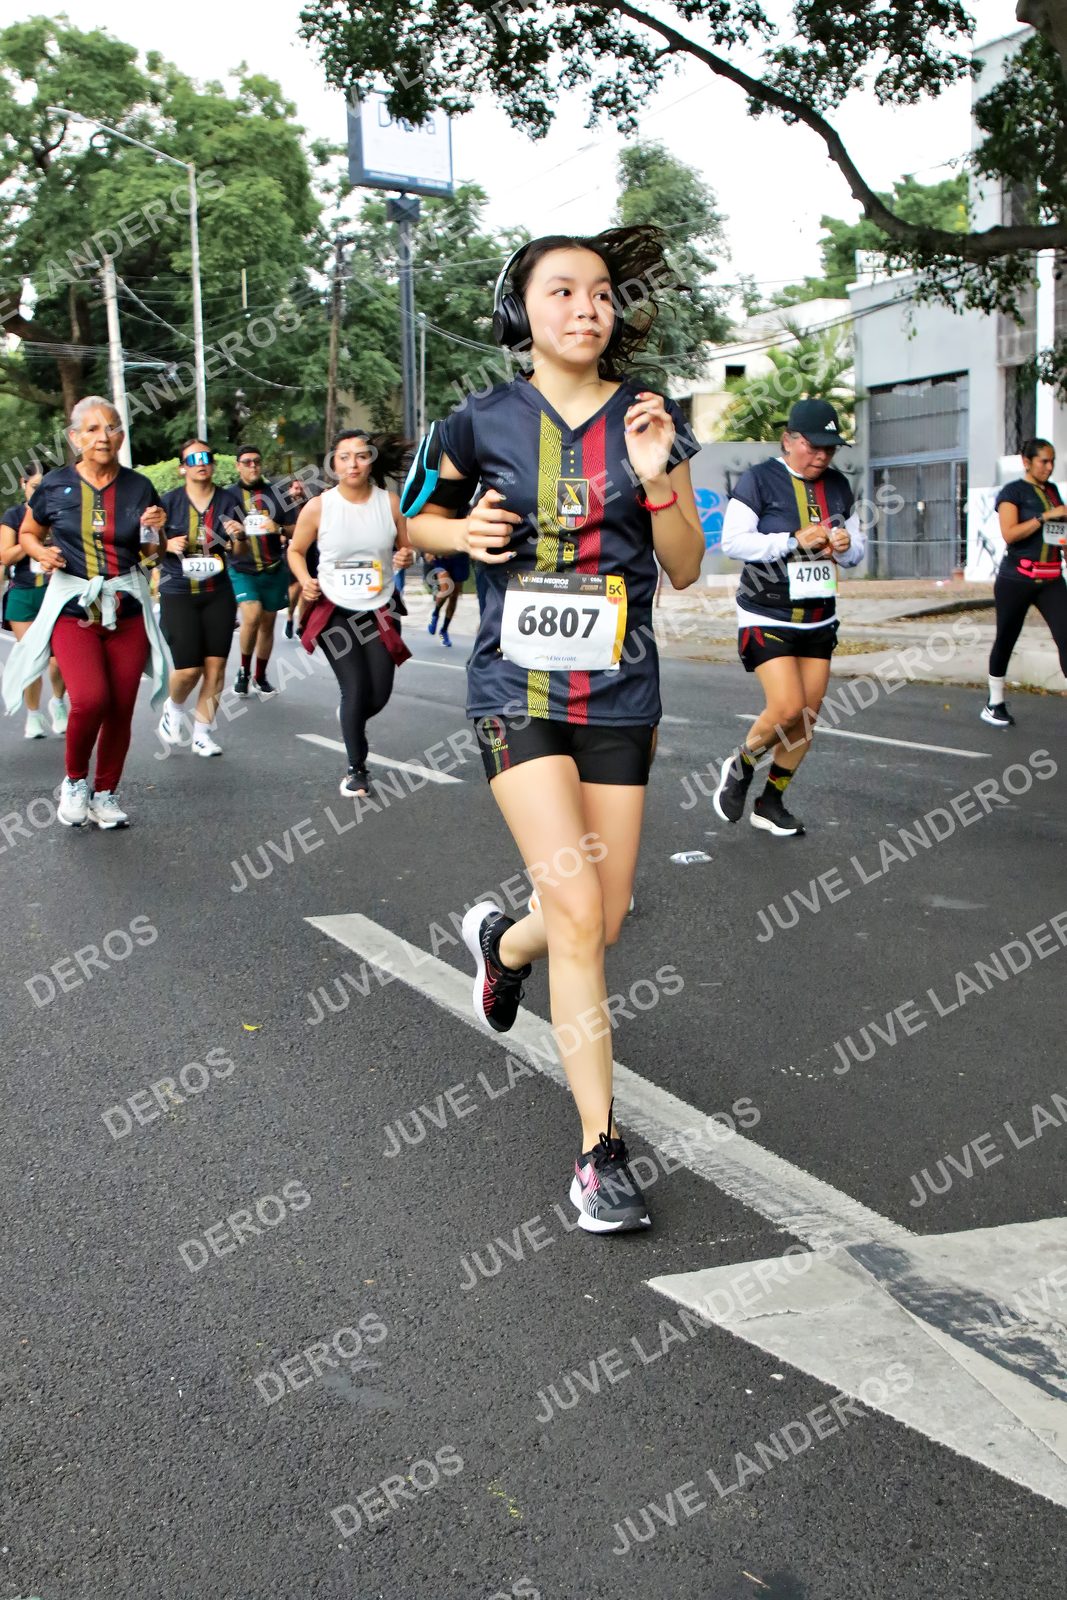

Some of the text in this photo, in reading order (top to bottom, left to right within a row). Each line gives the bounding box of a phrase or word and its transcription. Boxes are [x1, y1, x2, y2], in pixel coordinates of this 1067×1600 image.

[189, 561, 215, 572] 5210
[341, 573, 372, 586] 1575
[796, 566, 831, 582] 4708
[609, 584, 622, 596] 5K
[518, 605, 600, 638] 6807
